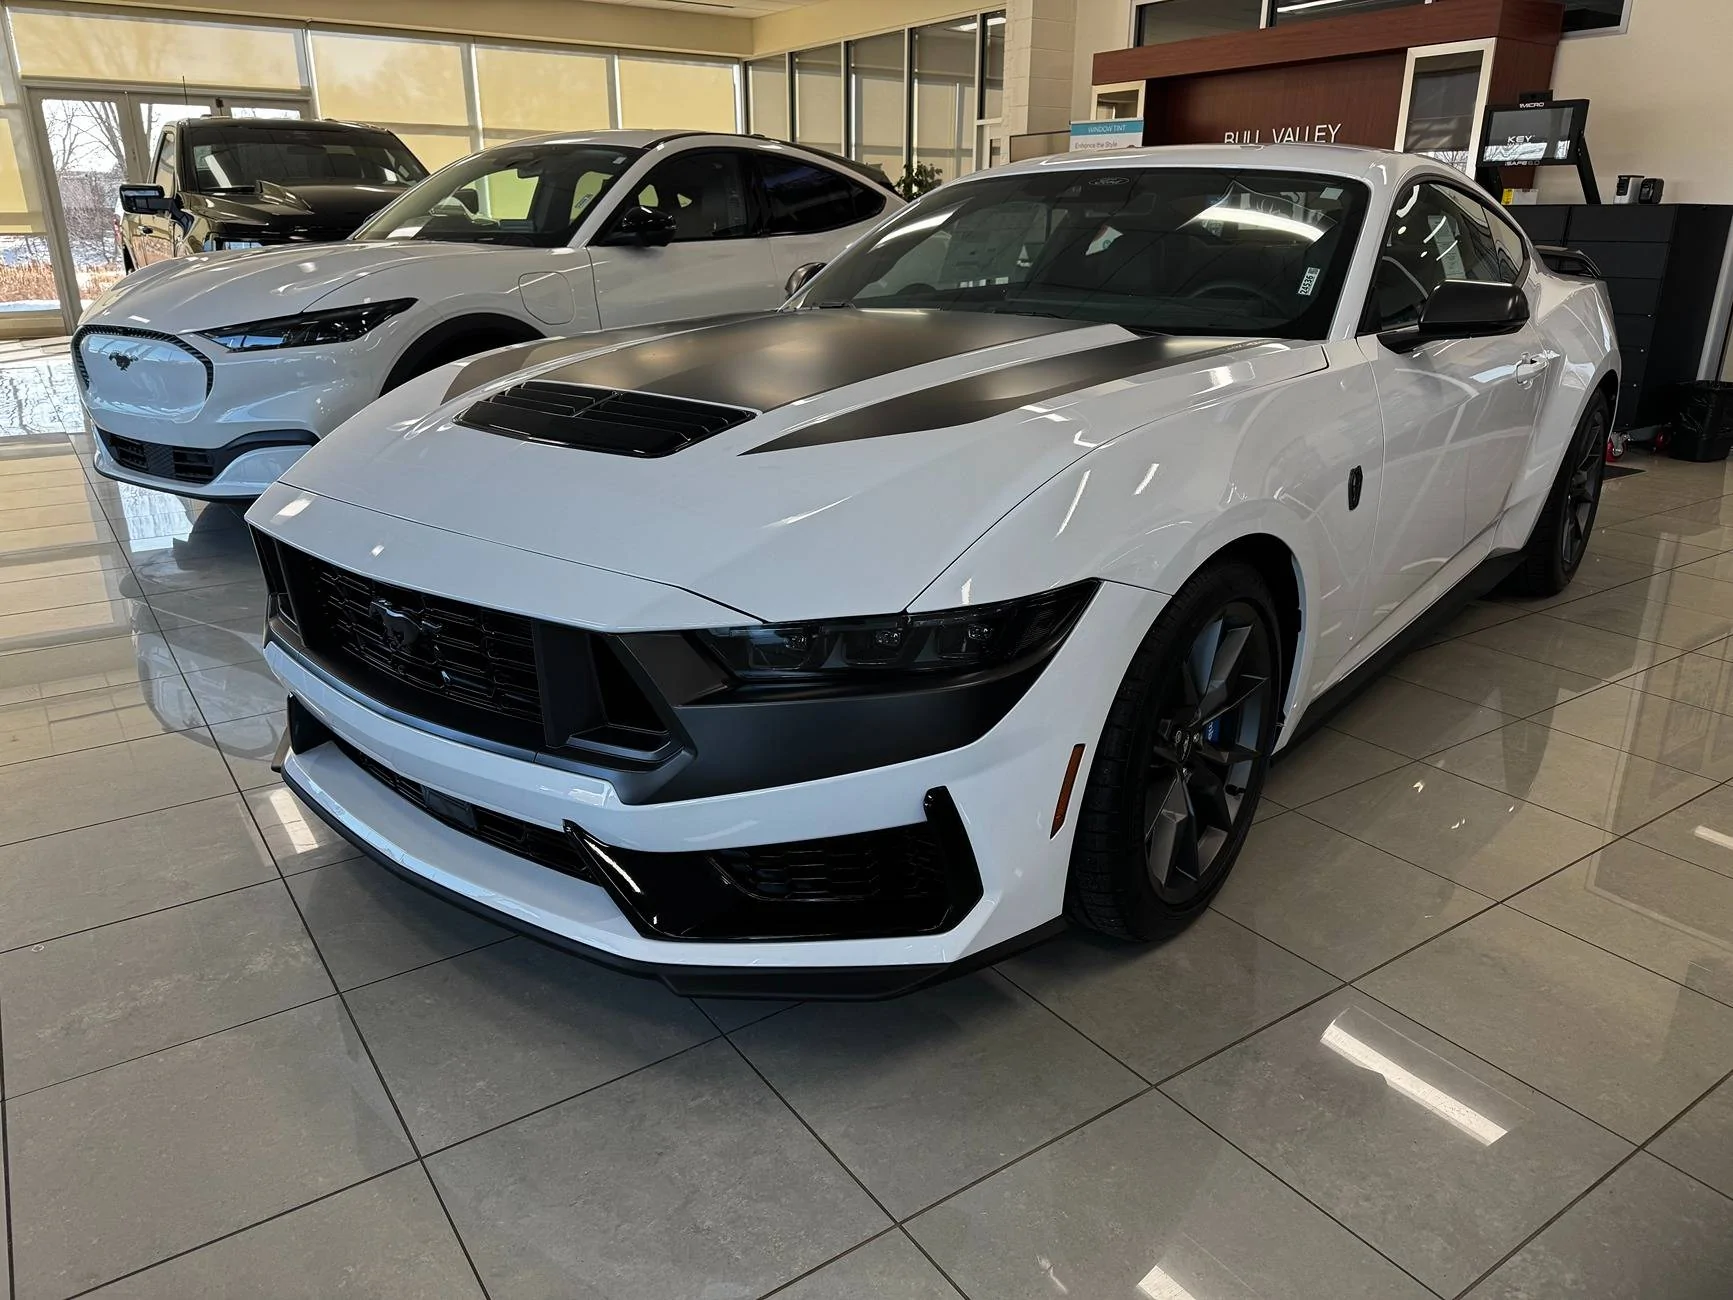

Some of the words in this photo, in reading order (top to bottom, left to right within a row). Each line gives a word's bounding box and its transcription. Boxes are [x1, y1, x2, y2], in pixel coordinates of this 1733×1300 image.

[1088, 124, 1112, 133] WINDOW
[1113, 124, 1126, 132] TINT
[1272, 123, 1342, 143] VALLEY
[1507, 135, 1532, 143] KEY
